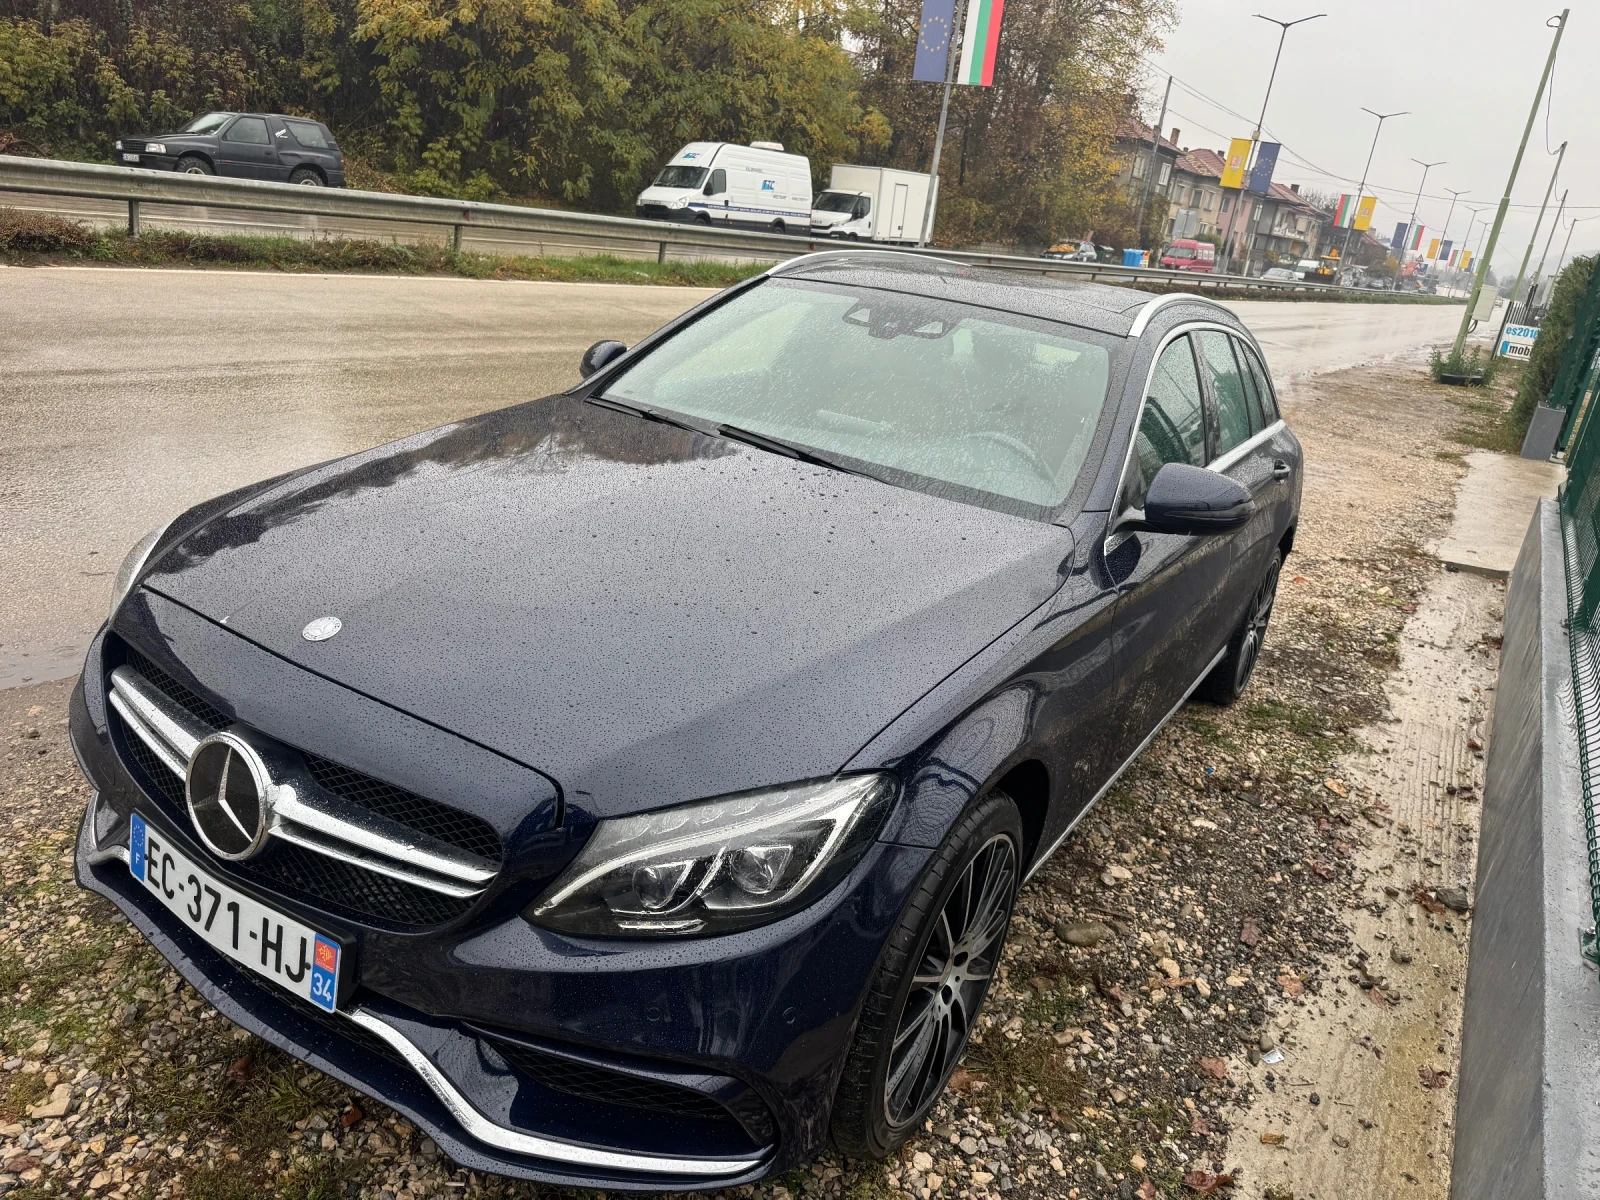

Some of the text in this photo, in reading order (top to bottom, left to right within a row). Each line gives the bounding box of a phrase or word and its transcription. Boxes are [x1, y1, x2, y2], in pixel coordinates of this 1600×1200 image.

[135, 852, 141, 864] F
[147, 837, 307, 983] EC-371-HJ
[313, 972, 332, 1002] 34
